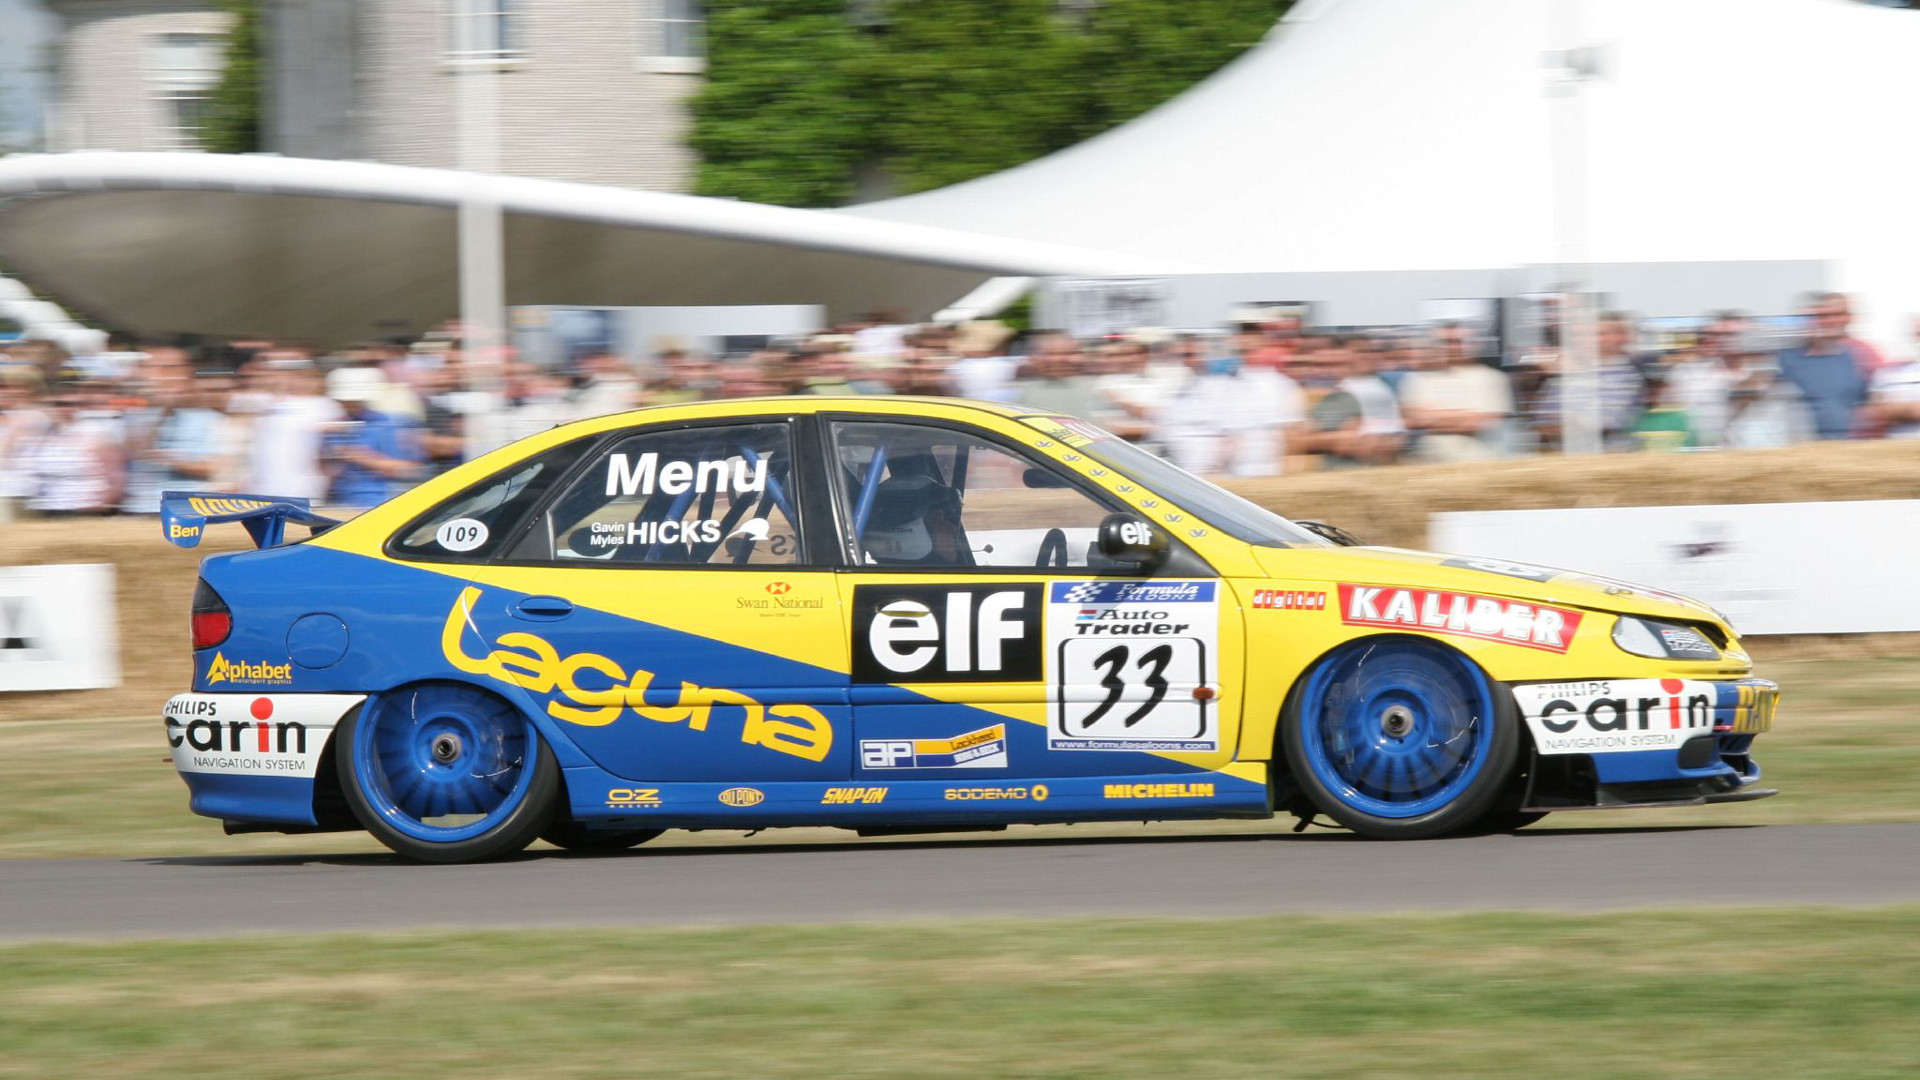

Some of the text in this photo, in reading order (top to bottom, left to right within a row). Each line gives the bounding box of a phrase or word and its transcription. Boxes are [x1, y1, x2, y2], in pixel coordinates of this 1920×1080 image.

[605, 452, 769, 496] Menu
[170, 524, 199, 538] Ben
[446, 526, 479, 543] 109
[591, 522, 625, 533] Gavin
[627, 520, 720, 545] HICKS
[1120, 521, 1152, 546] elf
[590, 535, 625, 548] Myles
[1117, 583, 1200, 595] Formula
[736, 596, 824, 609] Swan National
[1253, 592, 1325, 608] digital
[1096, 609, 1169, 620] Auto
[1349, 586, 1564, 647] KALIBER
[869, 591, 1025, 673] elf
[1074, 622, 1190, 635] Trader
[205, 651, 292, 686] Alphabet
[441, 585, 833, 762] Laguna
[1082, 643, 1173, 729] 33
[165, 700, 217, 716] PHILIPS
[1541, 679, 1709, 733] carin
[165, 697, 306, 753] carin
[1055, 740, 1211, 750] www.formulasaloons.com
[1545, 735, 1677, 749] NAVIGATION SYSTEM
[194, 757, 306, 770] NAVIGATION SYSTEM
[944, 788, 1027, 800] SODEMO
[1104, 783, 1214, 798] MICHELIN
